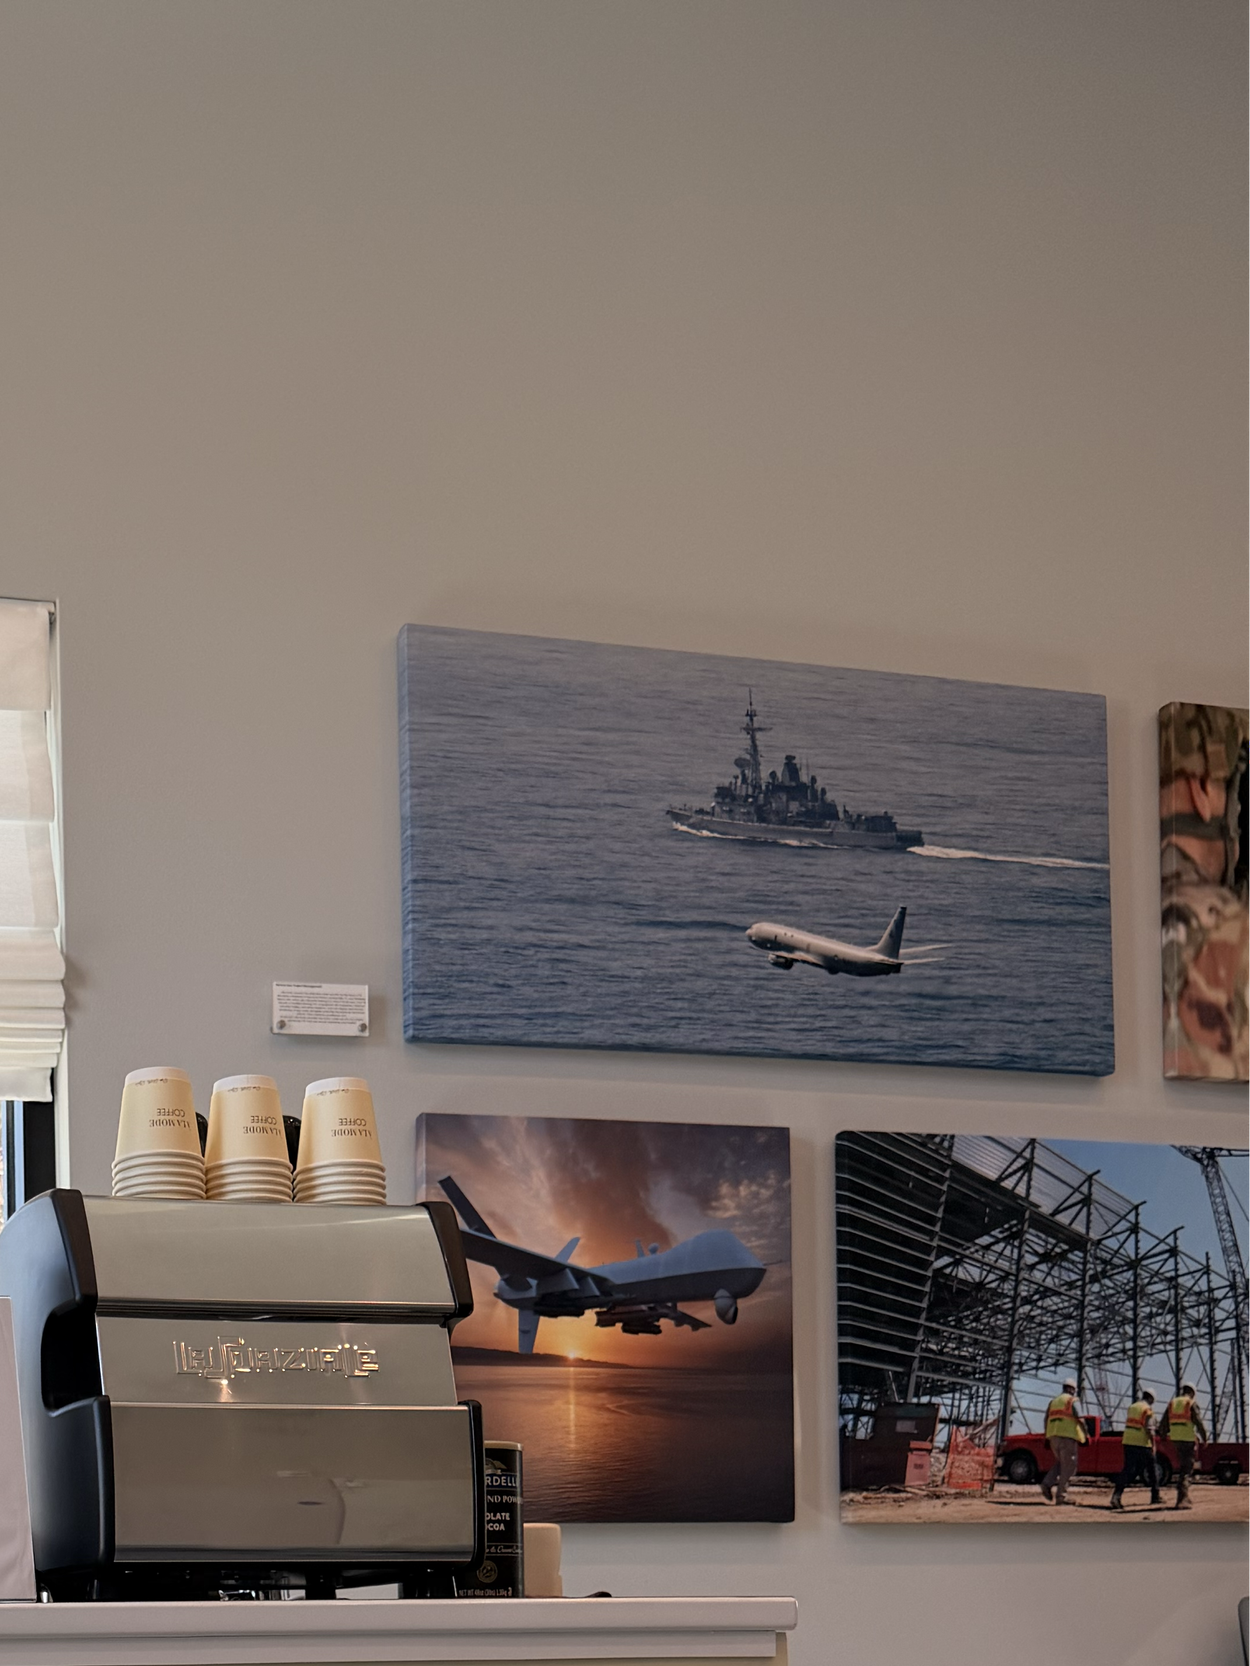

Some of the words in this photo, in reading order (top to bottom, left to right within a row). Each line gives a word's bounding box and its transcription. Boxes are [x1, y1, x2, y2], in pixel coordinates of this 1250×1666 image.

[156, 1108, 186, 1118] COFFEE
[149, 1119, 176, 1128] MODE
[250, 1115, 278, 1125] COFFEE
[338, 1117, 367, 1127] COFFEE
[243, 1126, 269, 1135] MODE
[331, 1128, 357, 1137] MODE
[485, 1512, 511, 1521] OLATE
[485, 1523, 505, 1531] COA
